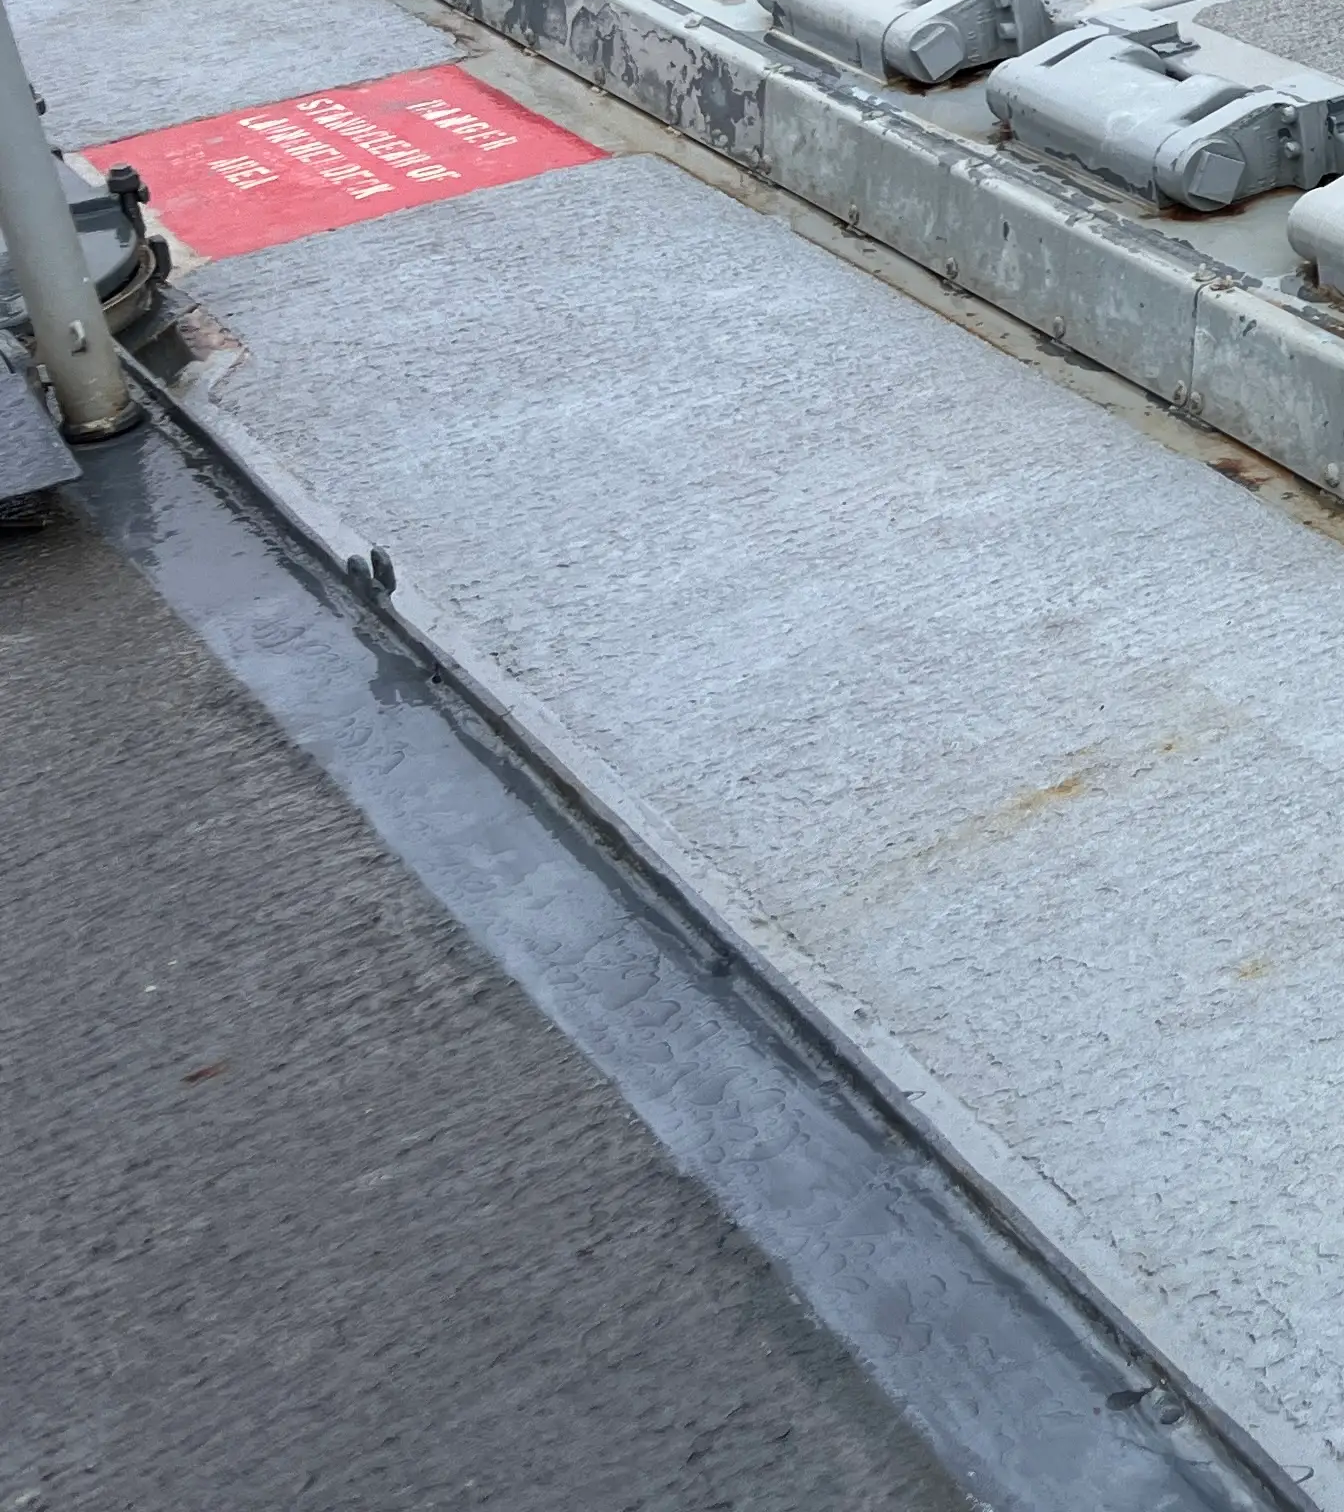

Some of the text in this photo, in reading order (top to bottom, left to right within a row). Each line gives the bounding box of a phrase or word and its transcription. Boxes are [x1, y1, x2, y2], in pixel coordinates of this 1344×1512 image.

[406, 99, 518, 151] DANGER
[206, 155, 280, 190] AREA
[405, 164, 463, 183] OF
